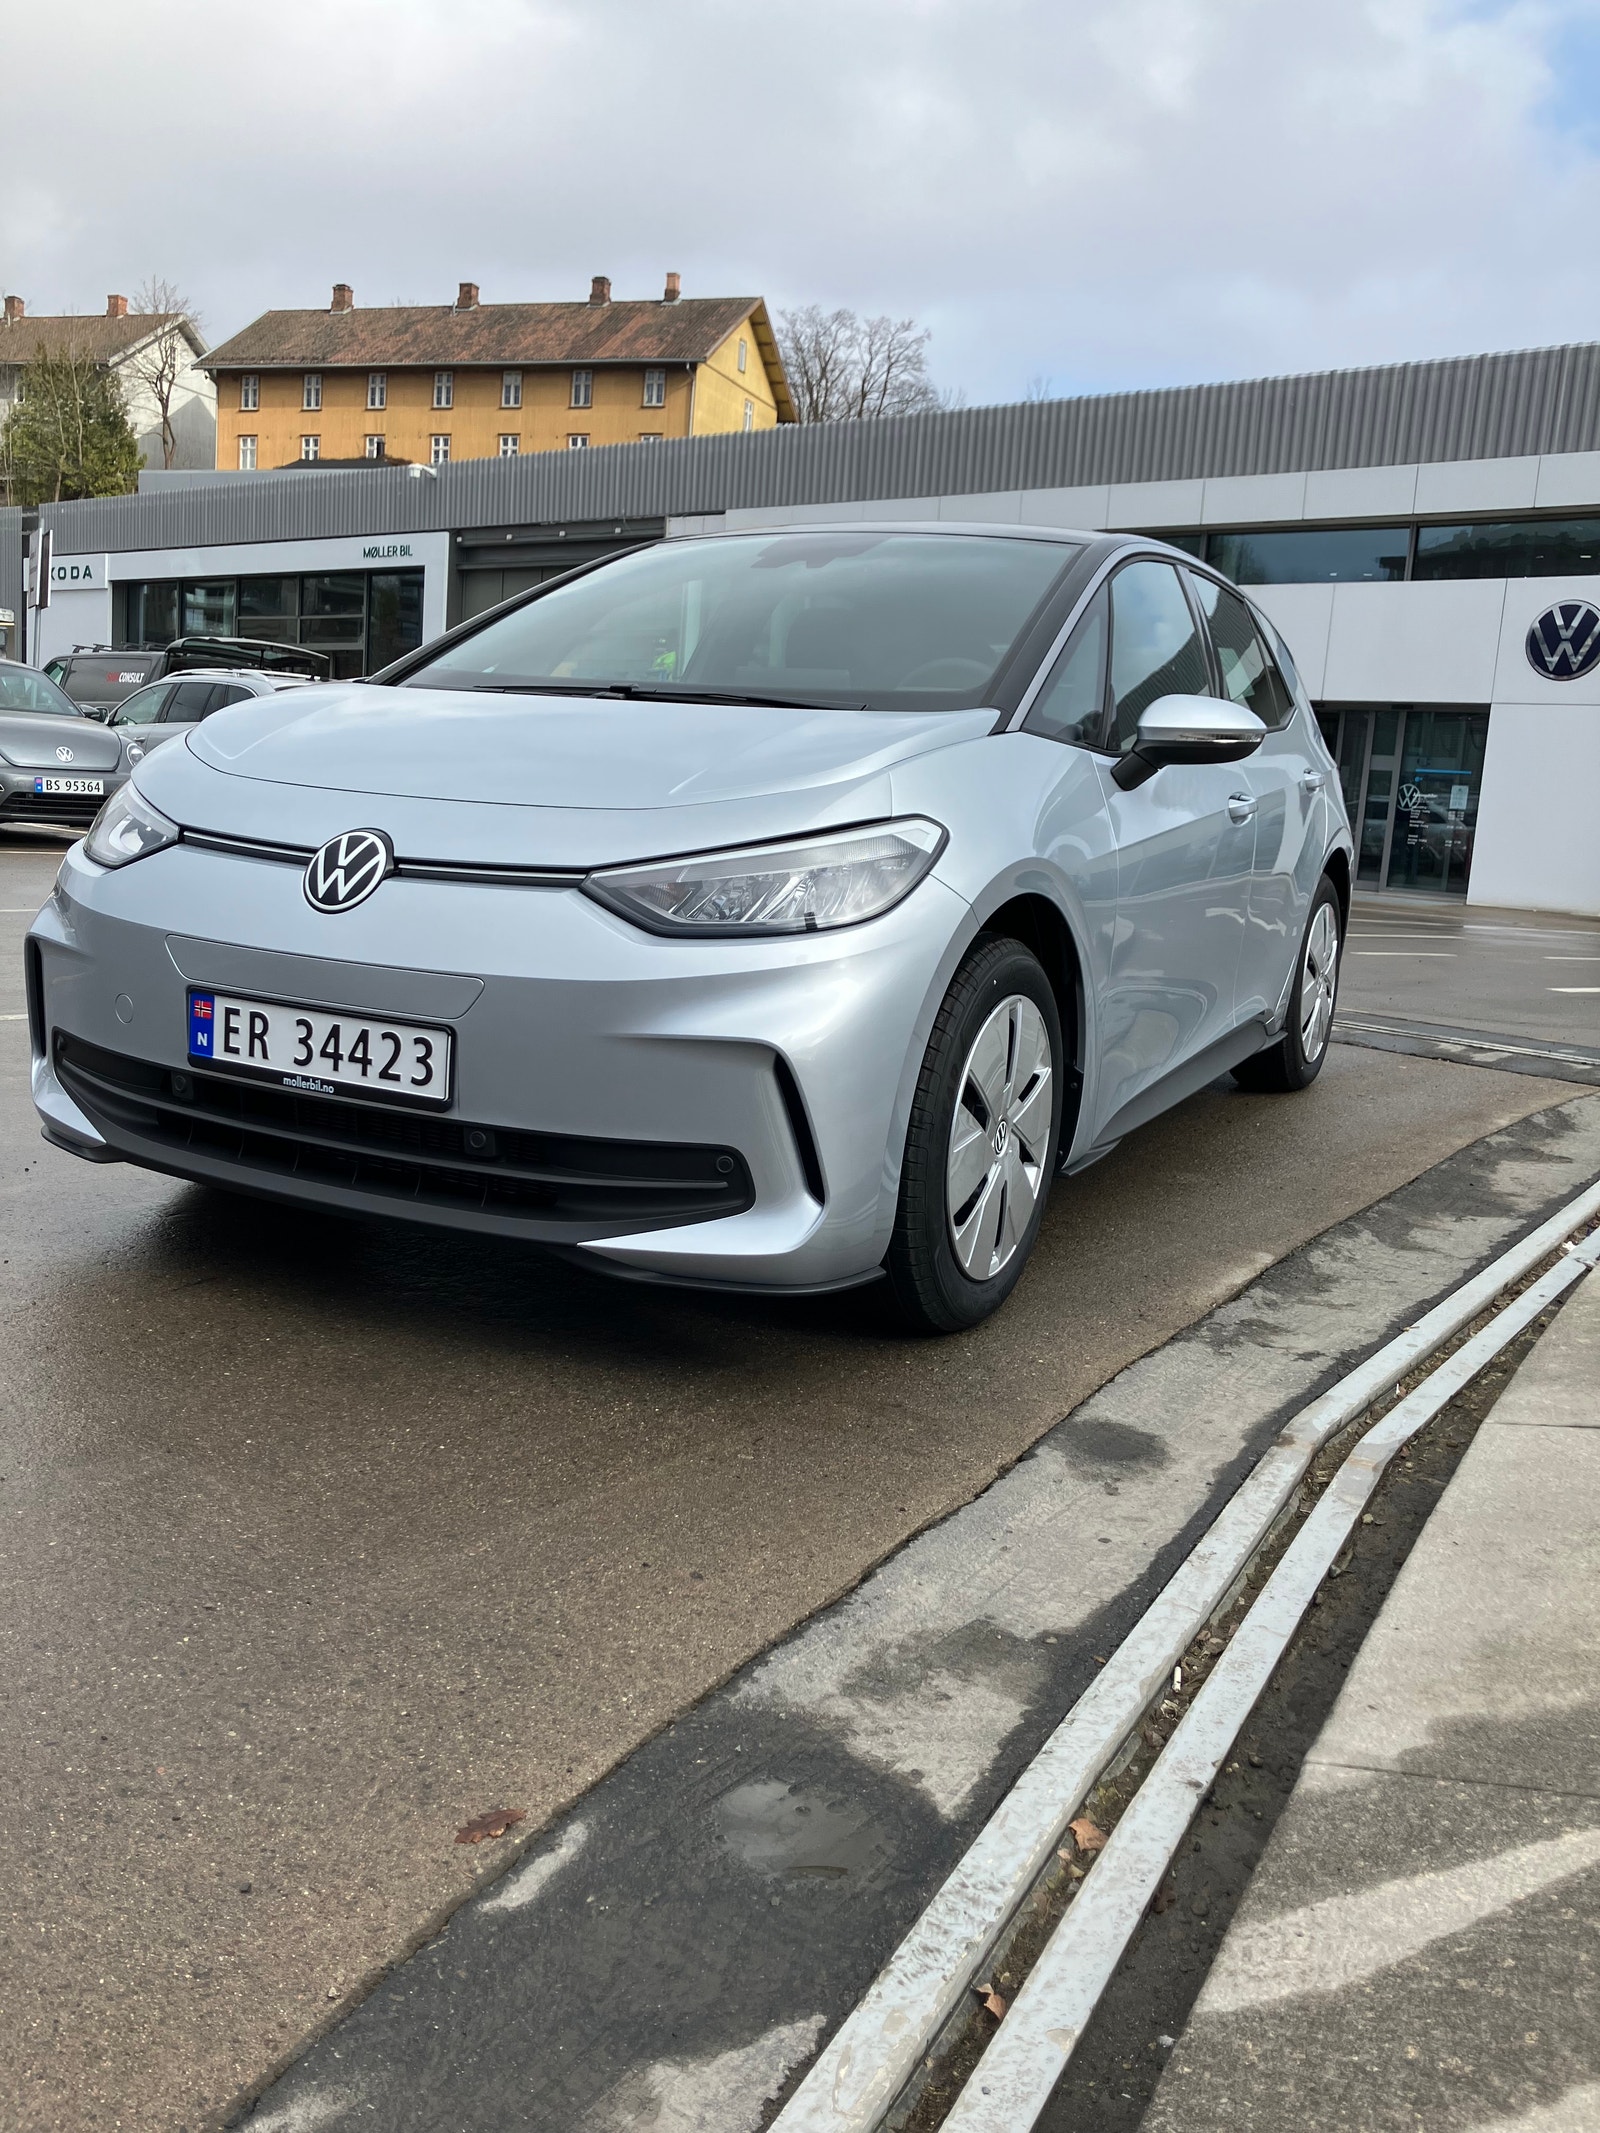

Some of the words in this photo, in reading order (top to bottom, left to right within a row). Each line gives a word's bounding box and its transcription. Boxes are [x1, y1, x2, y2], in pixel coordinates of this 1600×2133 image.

[363, 545, 398, 558] MØLLER
[400, 544, 413, 557] BIL
[46, 779, 60, 791] BS
[65, 780, 101, 793] 95364
[197, 1031, 208, 1047] N
[224, 1006, 270, 1060] ER
[293, 1017, 434, 1087] 34423
[283, 1075, 335, 1094] mollerbil.no
